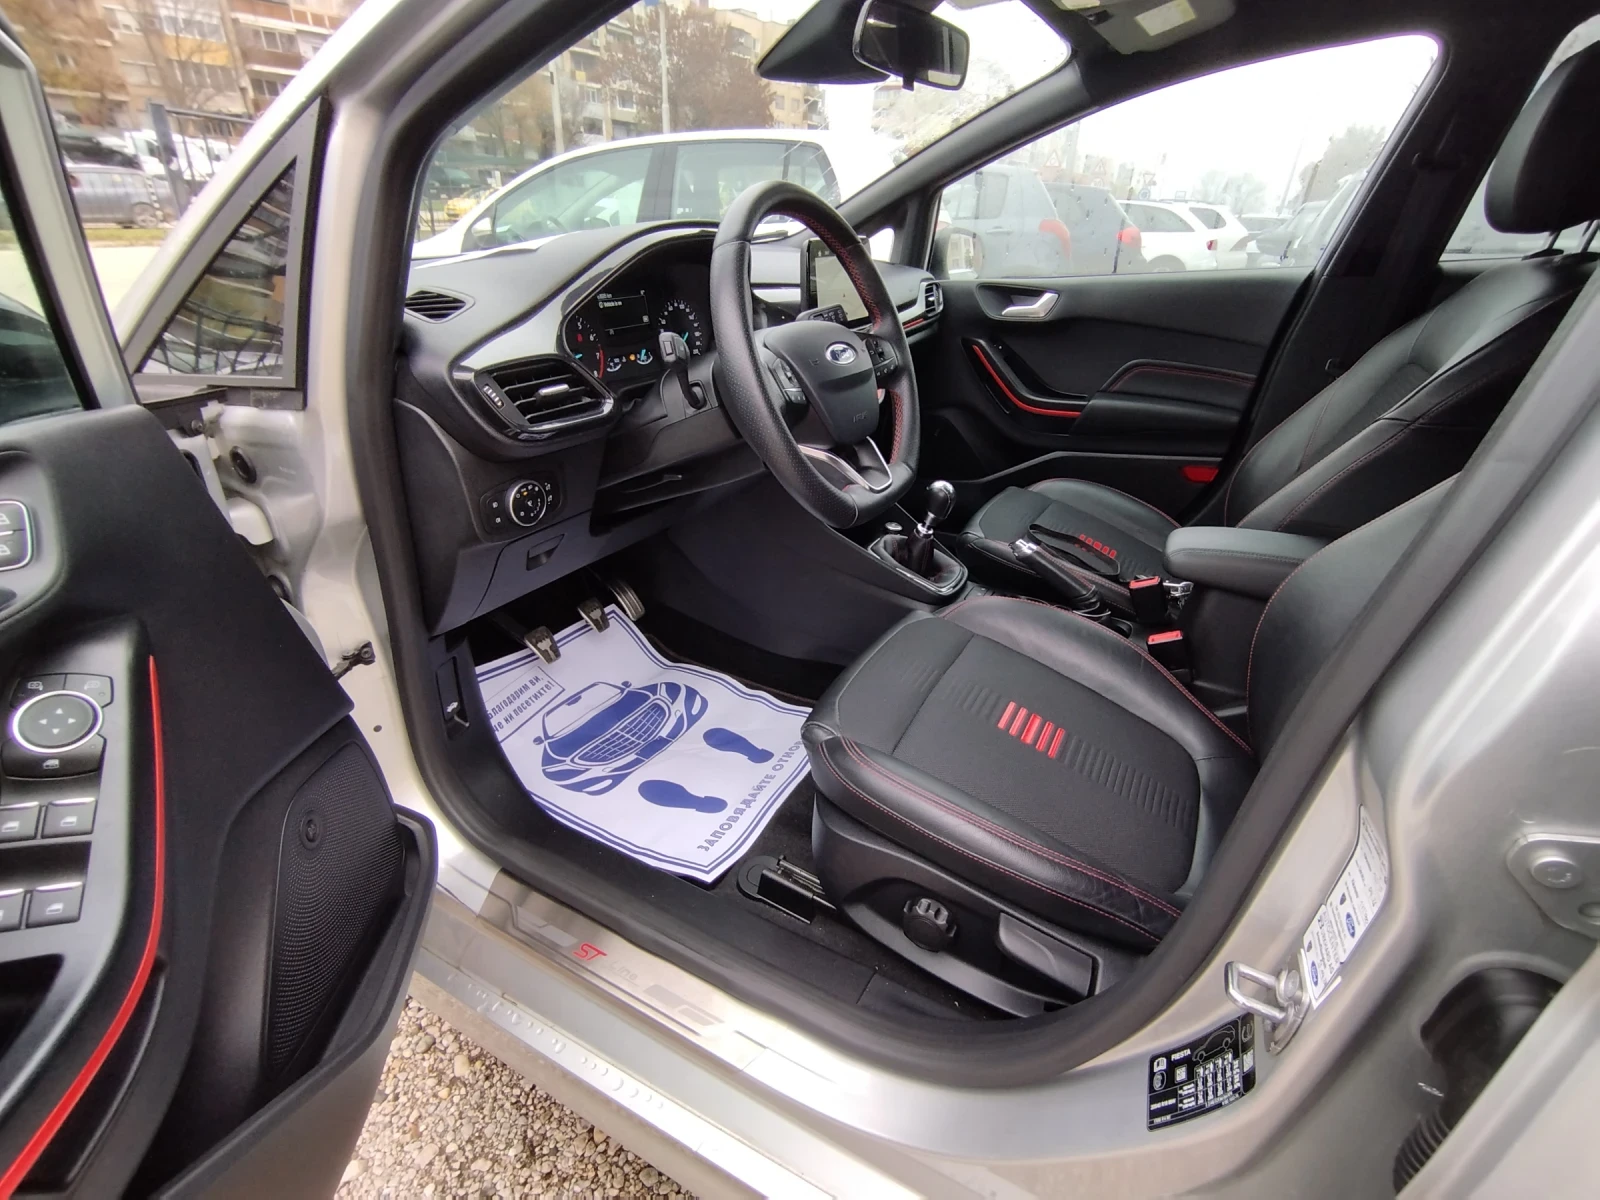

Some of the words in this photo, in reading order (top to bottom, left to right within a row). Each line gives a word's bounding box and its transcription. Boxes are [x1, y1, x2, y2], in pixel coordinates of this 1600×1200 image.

[697, 774, 776, 852] ЗАПОВЯДАЙТЕ
[573, 942, 608, 961] ST
[1171, 1049, 1191, 1061] FIESTA
